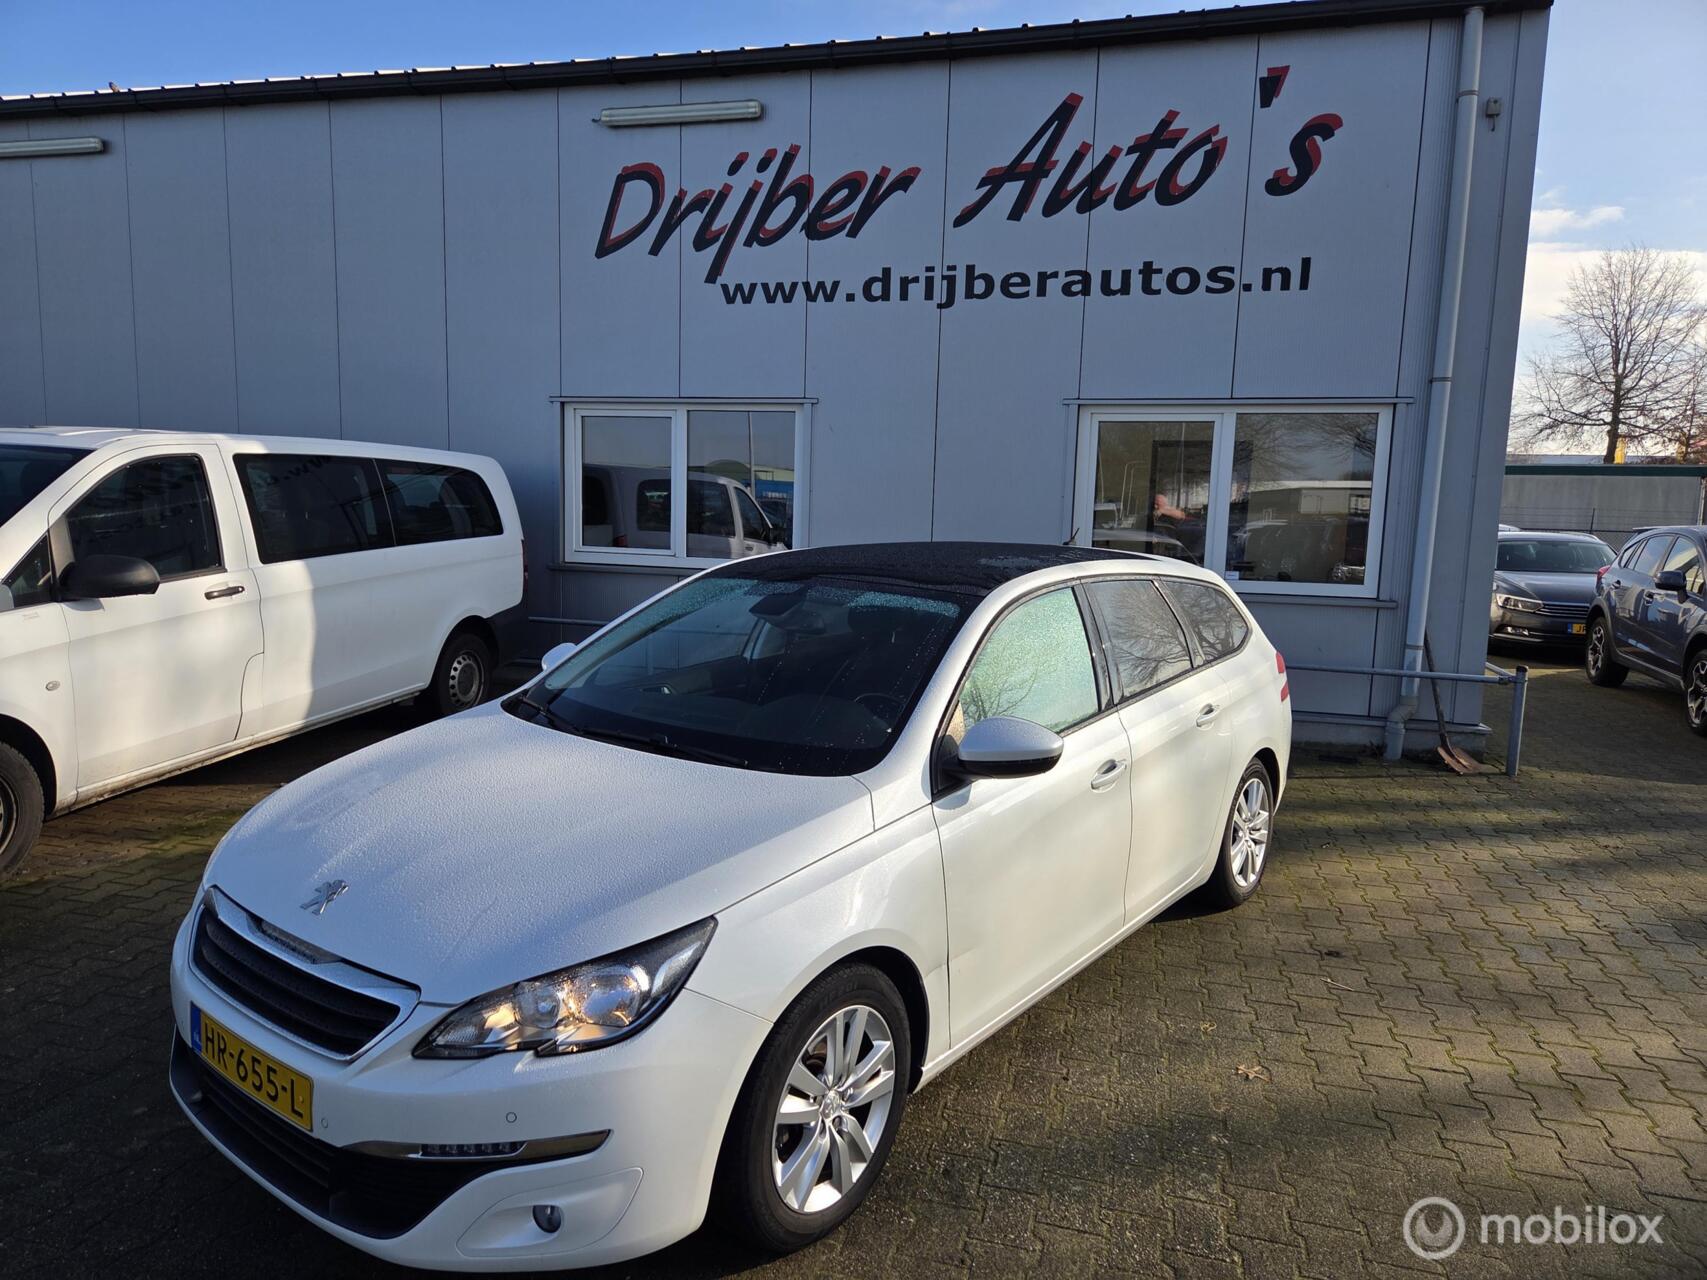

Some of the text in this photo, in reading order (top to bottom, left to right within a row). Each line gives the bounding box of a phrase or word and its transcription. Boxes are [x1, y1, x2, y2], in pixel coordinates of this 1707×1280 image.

[595, 65, 1344, 284] Drijber Auto's
[720, 256, 1312, 309] www.drijberautos.nl
[204, 1020, 304, 1119] HR-655-L
